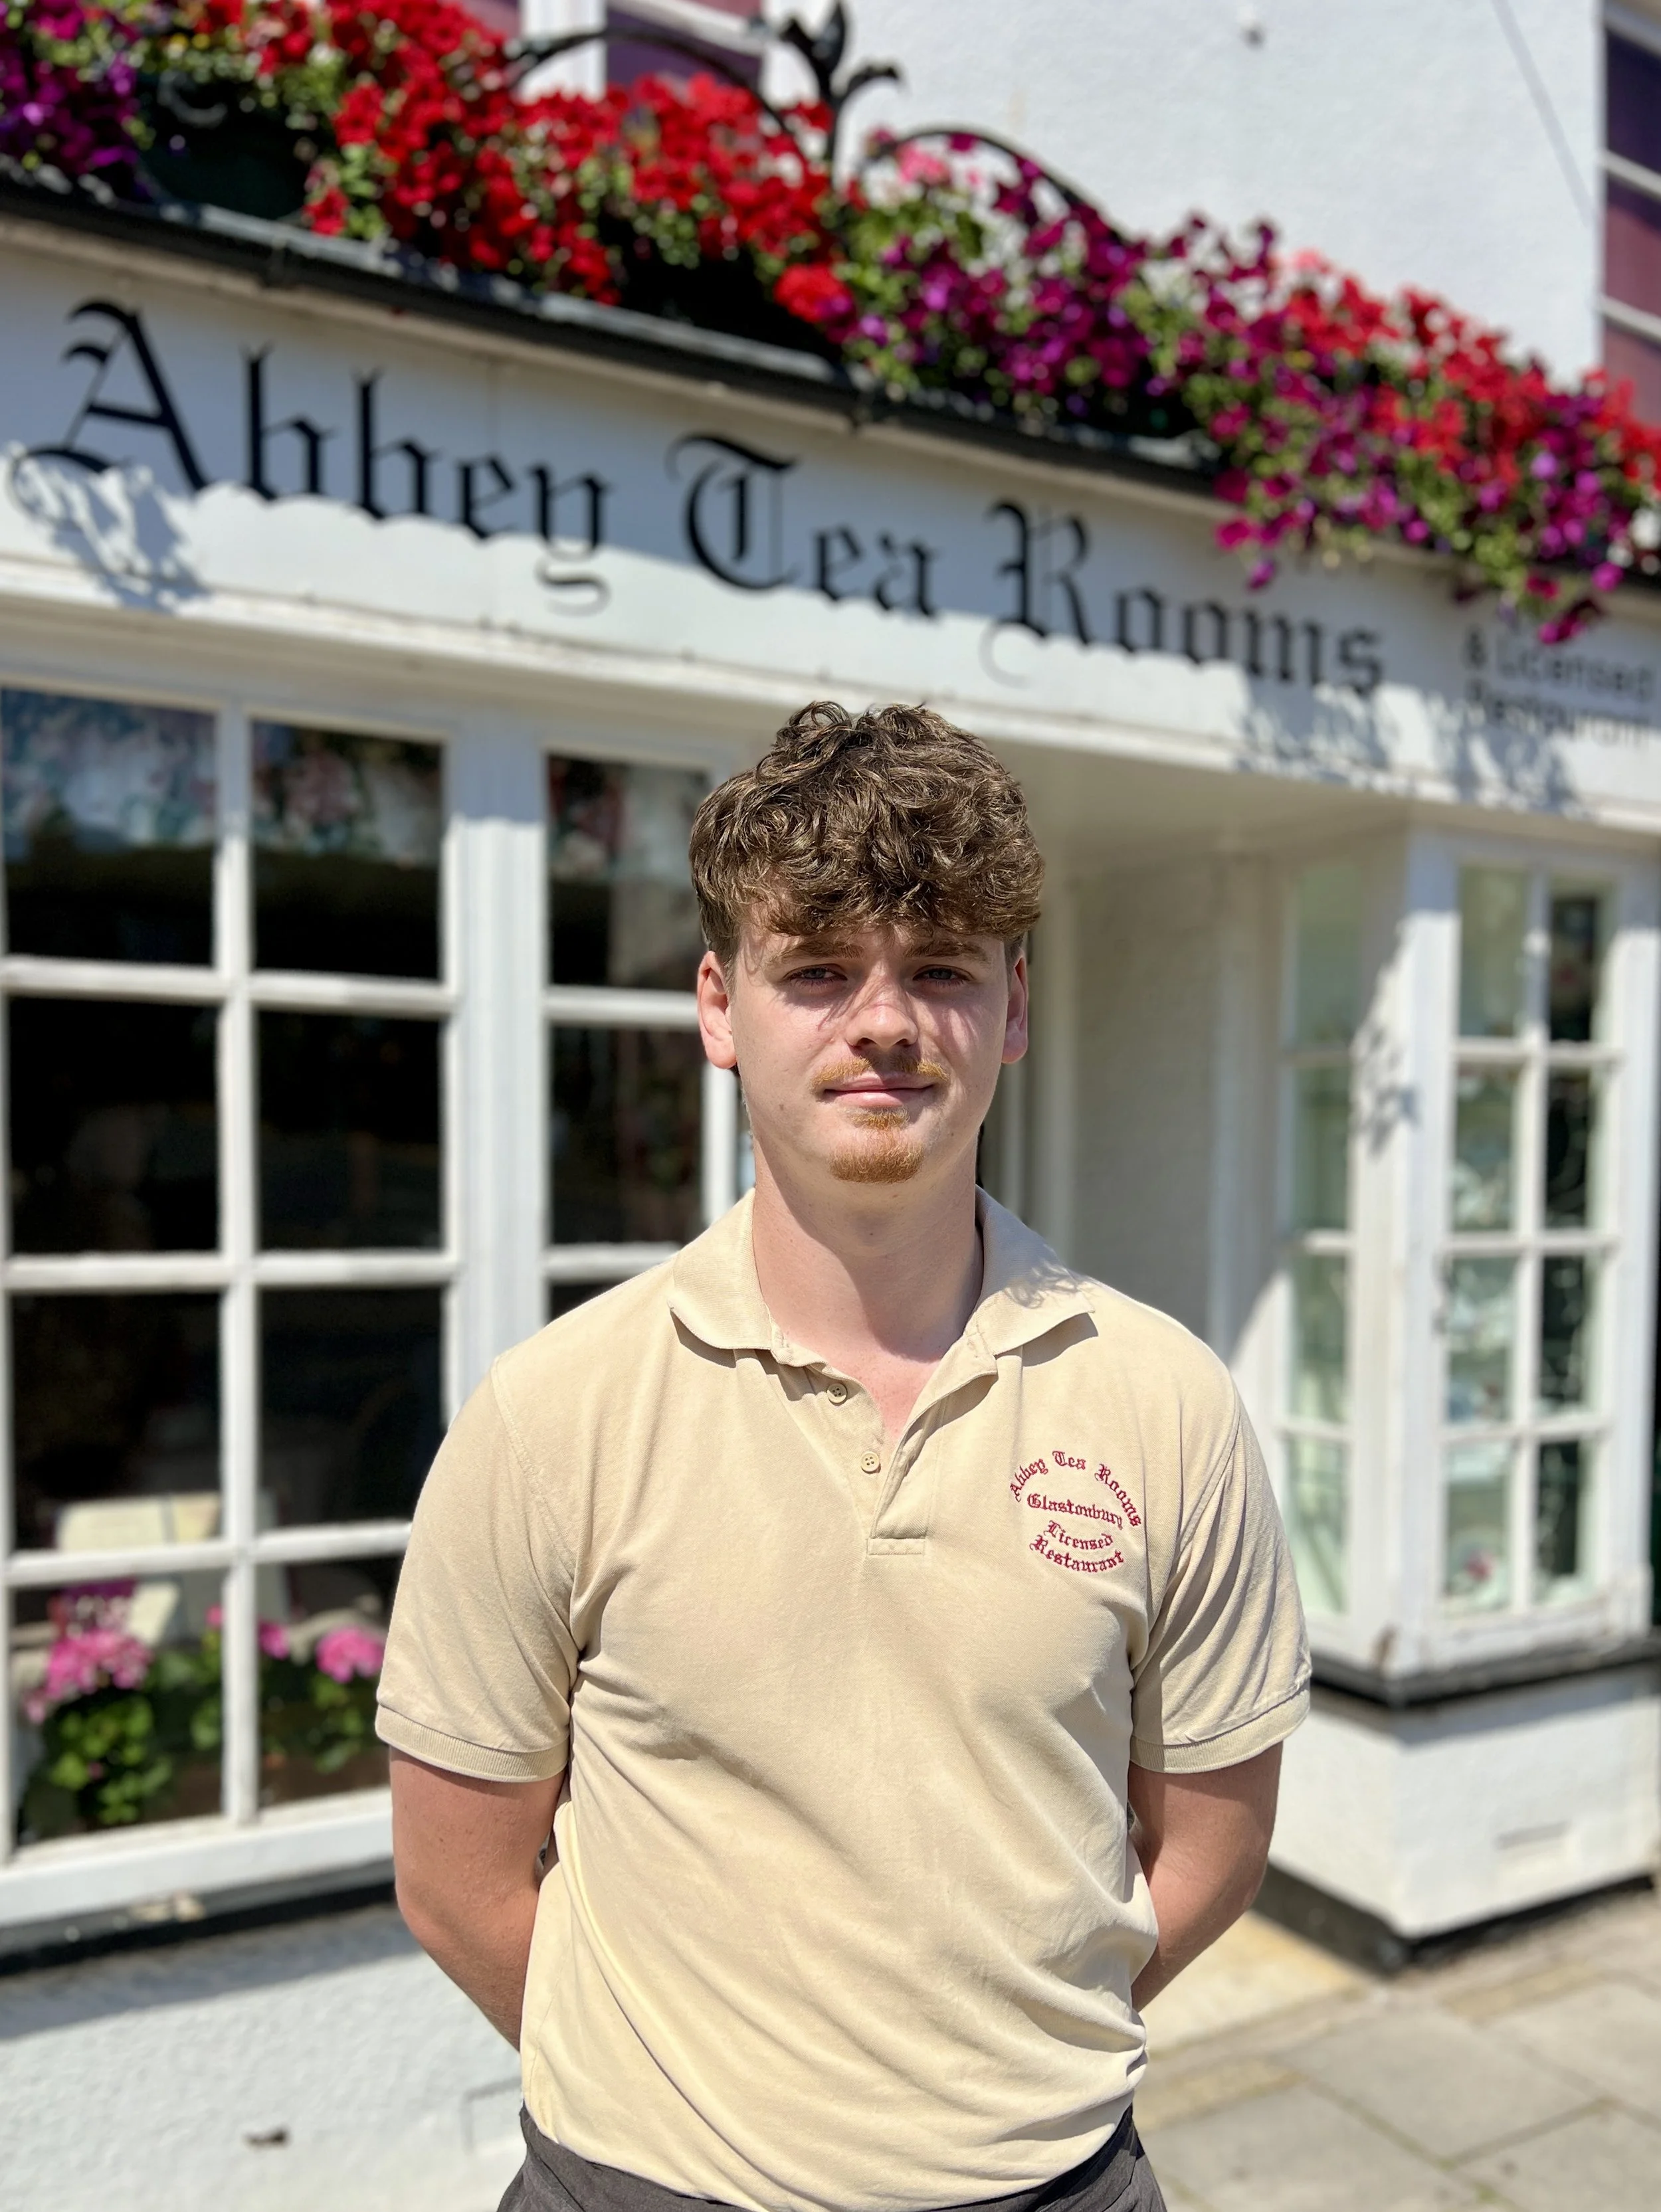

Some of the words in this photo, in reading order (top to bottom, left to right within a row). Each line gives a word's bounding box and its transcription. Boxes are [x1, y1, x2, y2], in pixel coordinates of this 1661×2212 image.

[8, 297, 614, 616] Abbey
[664, 432, 941, 619] Tea
[979, 498, 1385, 693] Rooms
[1010, 1459, 1048, 1502] Abbey
[1052, 1451, 1086, 1470] Tea
[1094, 1463, 1141, 1526] Rooms
[1027, 1493, 1123, 1530] Glastonbury
[1030, 1534, 1124, 1572] Restaurant
[1044, 1520, 1113, 1550] Licensed
